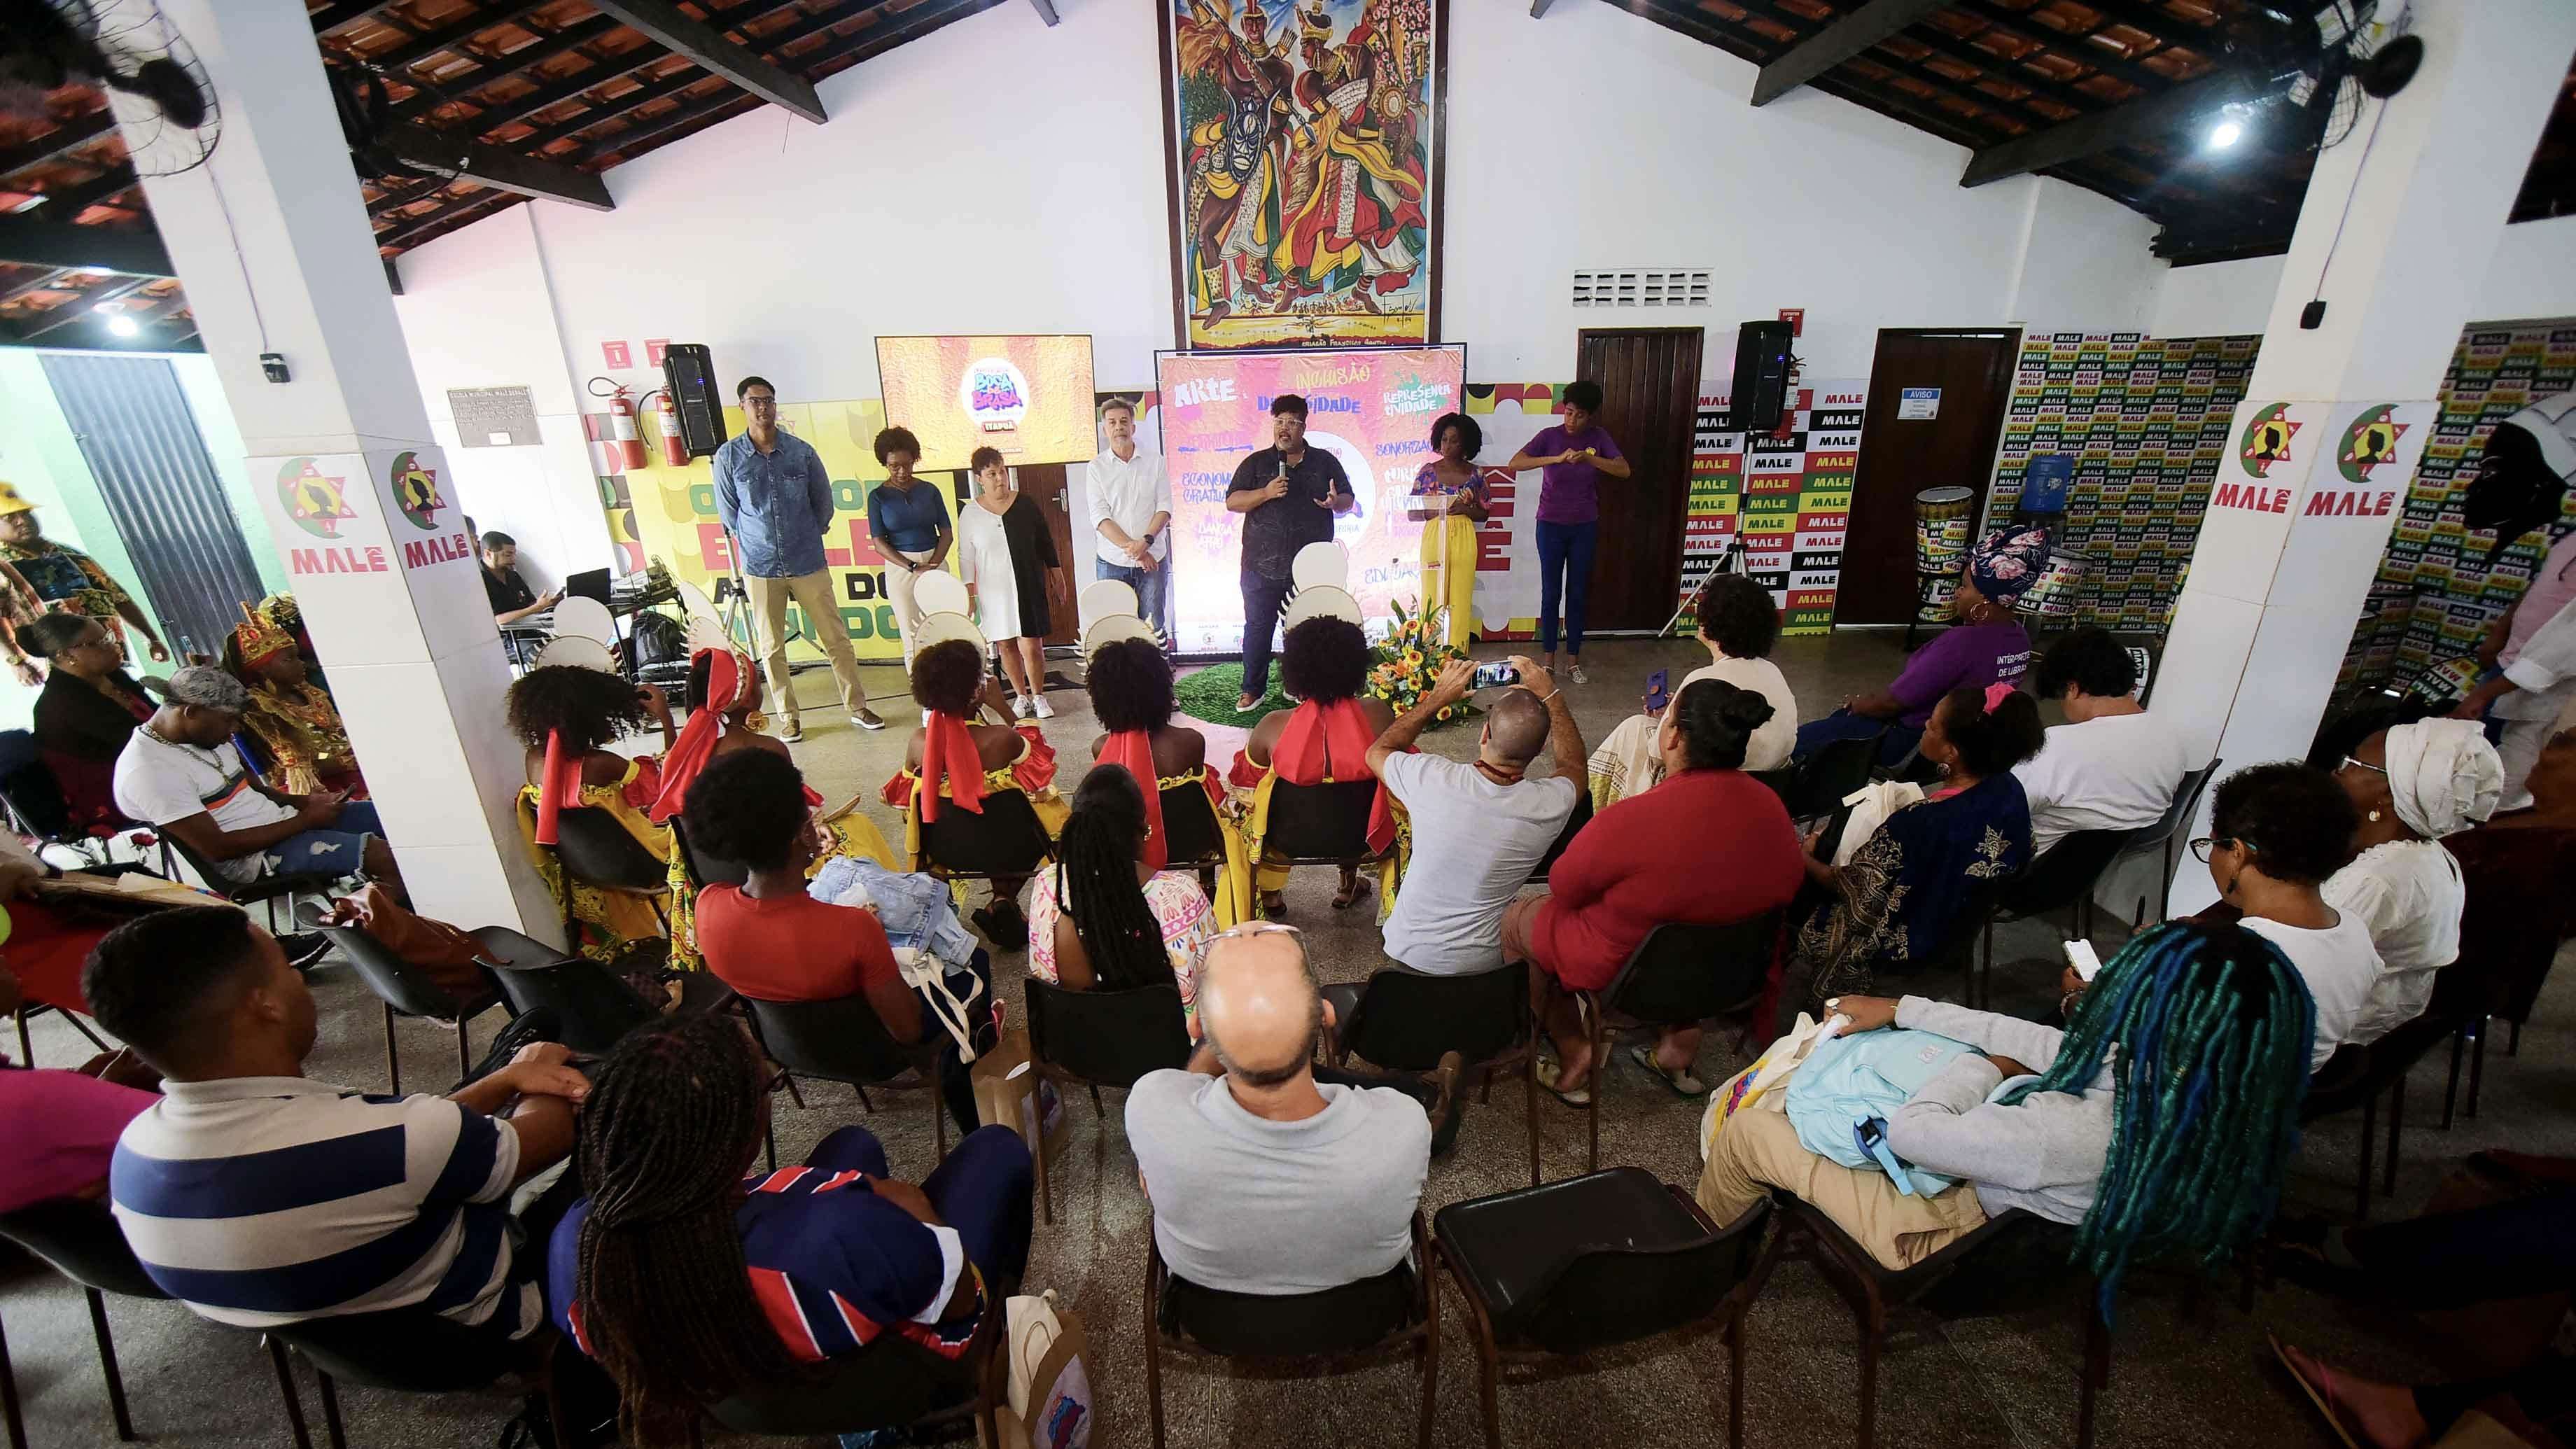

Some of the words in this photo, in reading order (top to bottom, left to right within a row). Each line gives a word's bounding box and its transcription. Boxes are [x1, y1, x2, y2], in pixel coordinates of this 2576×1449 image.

[1698, 397, 1730, 406] MAL
[1696, 419, 1729, 427] MAL
[2213, 483, 2291, 513] MALÊ
[2304, 492, 2396, 515] MALÊ
[291, 547, 388, 574] MALÊ
[405, 534, 469, 568] MALÊ
[1998, 668, 2007, 677] DE
